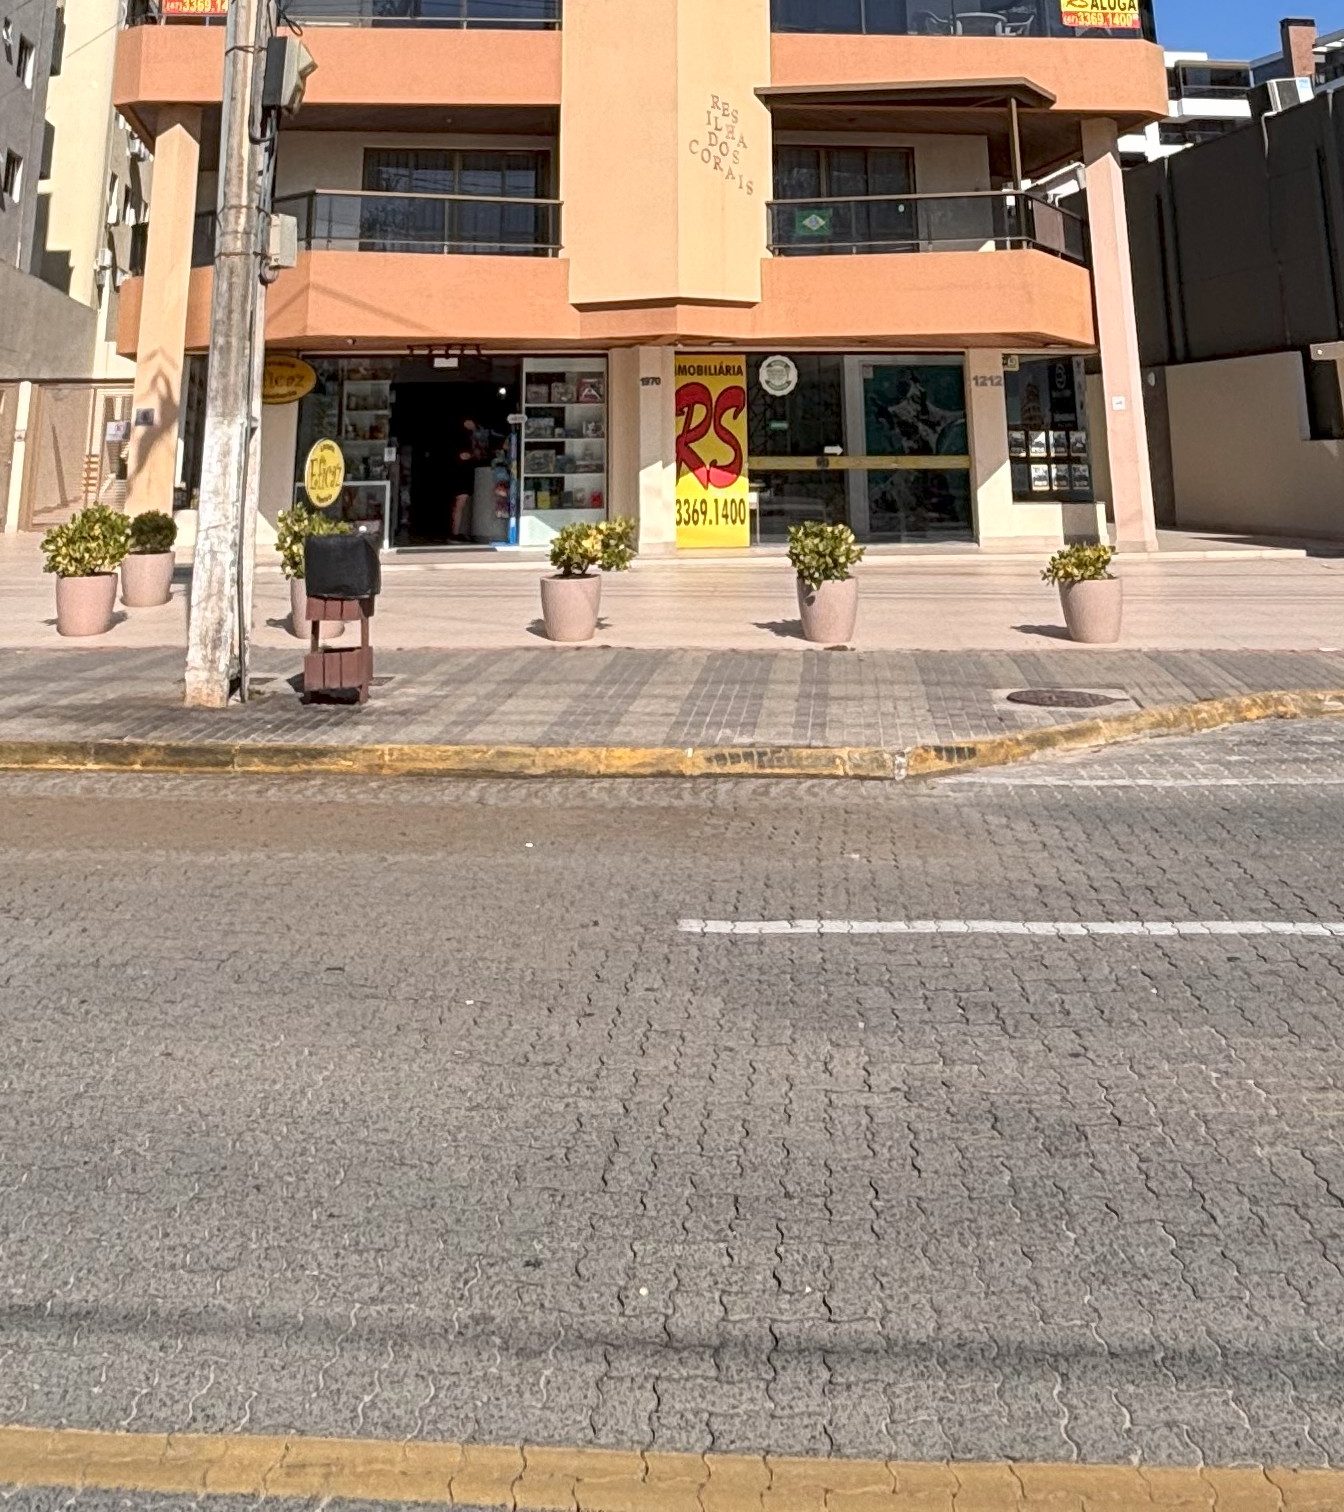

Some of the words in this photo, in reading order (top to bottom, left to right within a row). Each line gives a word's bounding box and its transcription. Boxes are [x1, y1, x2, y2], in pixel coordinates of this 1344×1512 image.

[711, 94, 739, 124] RES
[706, 110, 748, 149] ILHA
[708, 131, 740, 165] DOS
[688, 139, 754, 196] CORAIS
[675, 382, 746, 490] RS
[676, 497, 747, 526] 3369.1400
